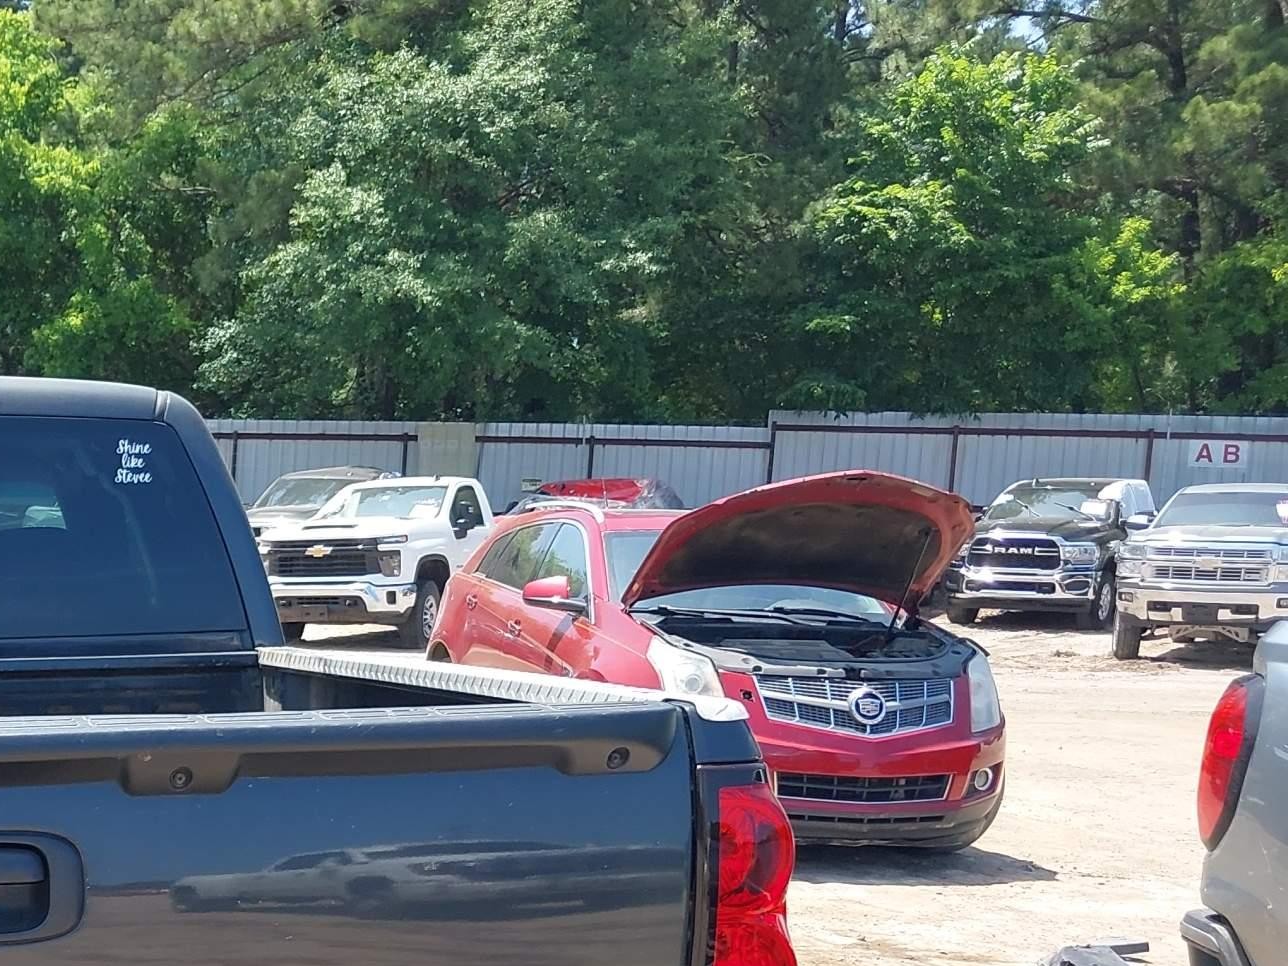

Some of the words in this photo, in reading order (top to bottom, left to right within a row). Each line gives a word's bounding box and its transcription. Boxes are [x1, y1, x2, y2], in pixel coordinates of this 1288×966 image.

[116, 439, 152, 454] Shine
[1195, 443, 1213, 463] A
[1223, 444, 1240, 463] B
[121, 453, 146, 468] like
[114, 468, 152, 483] Stevee
[993, 546, 1033, 555] RAM
